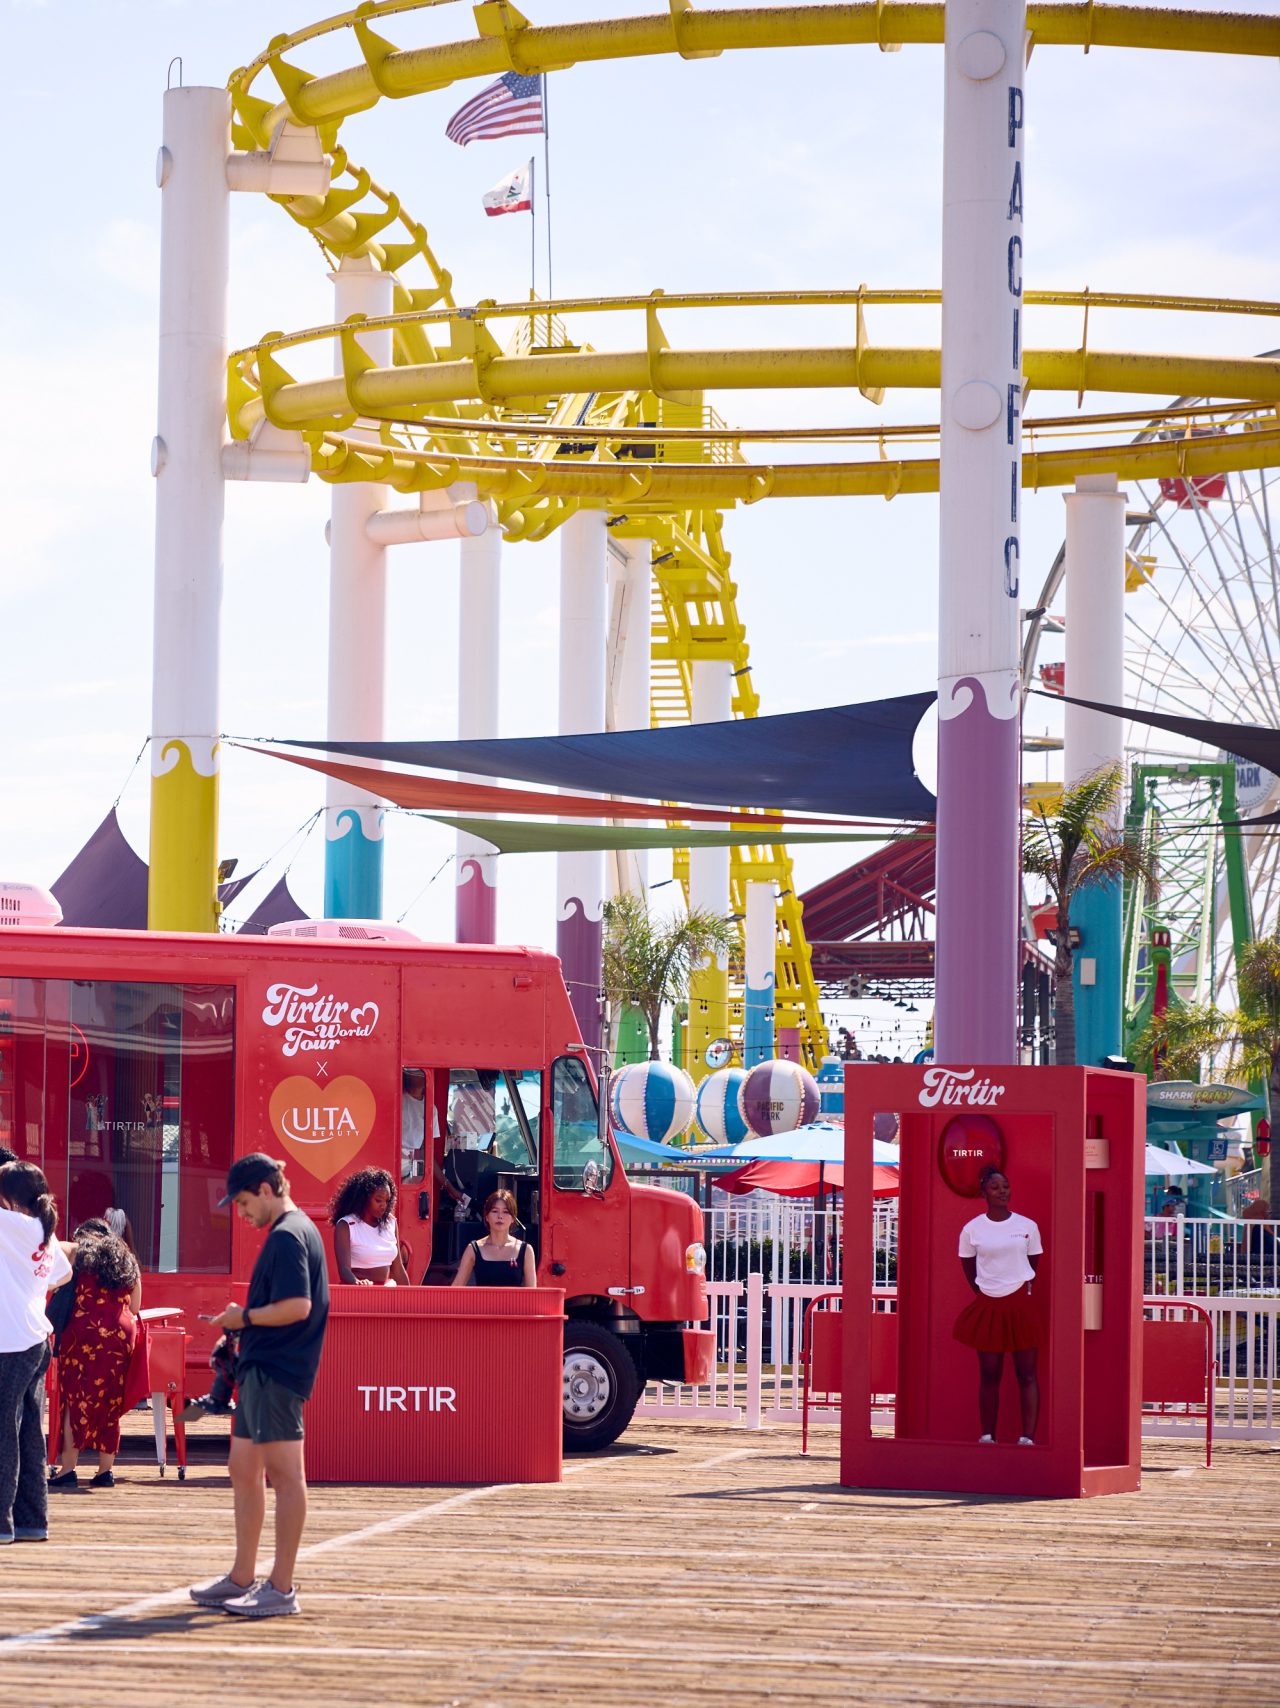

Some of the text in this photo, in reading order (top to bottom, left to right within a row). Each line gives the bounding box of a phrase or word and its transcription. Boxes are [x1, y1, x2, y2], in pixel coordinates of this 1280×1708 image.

[1003, 85, 1024, 599] PACIFIC
[262, 983, 349, 1026] Tirtir
[314, 1023, 372, 1039] World
[282, 1027, 341, 1057] Tour
[918, 1067, 1006, 1108] Tirtir
[1160, 1090, 1194, 1101] SHARK
[756, 1101, 785, 1112] PACIFIC
[761, 1111, 781, 1121] PARK
[104, 1121, 145, 1131] TIRTIR
[292, 1107, 357, 1132] ULTA
[952, 1149, 983, 1157] TIRTIR
[357, 1385, 457, 1412] TIRTIR
